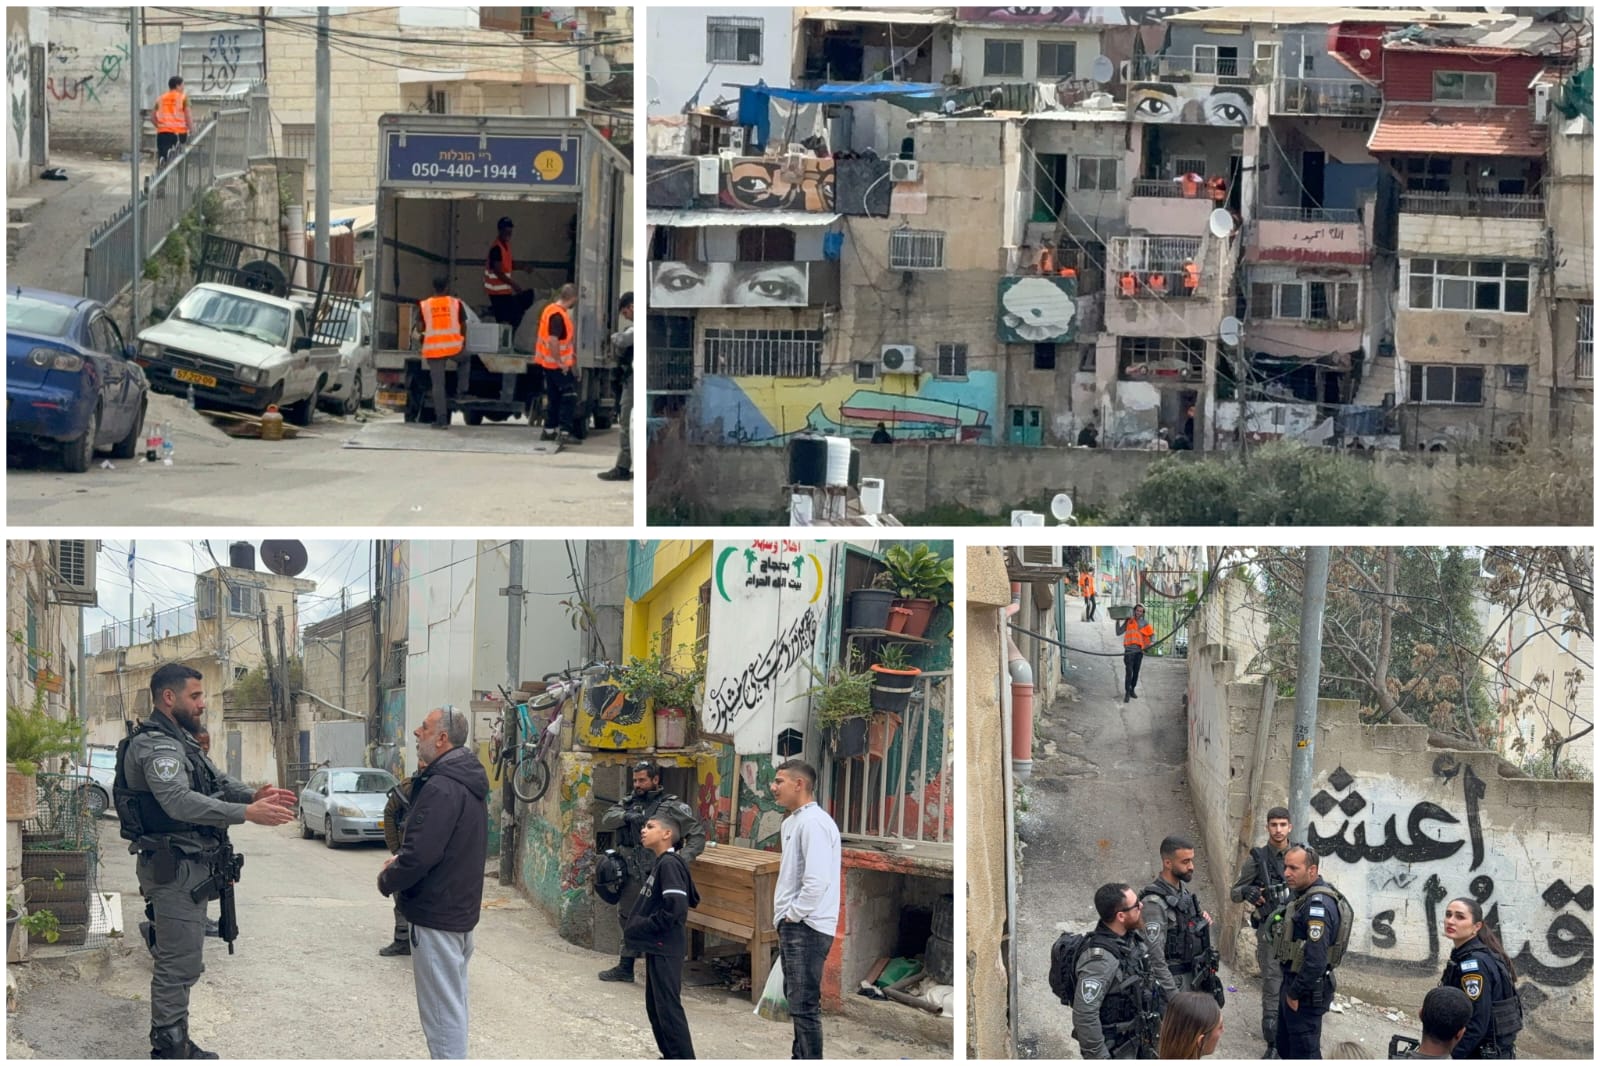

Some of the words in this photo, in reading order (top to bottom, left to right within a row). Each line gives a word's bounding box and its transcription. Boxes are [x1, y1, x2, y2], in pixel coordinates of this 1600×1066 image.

[438, 149, 475, 160] הובלות
[411, 162, 517, 179] 050-440-1944
[760, 556, 790, 573] بحجاج
[745, 574, 771, 590] الحرام
[772, 577, 787, 589] الله
[788, 579, 802, 591] بيت
